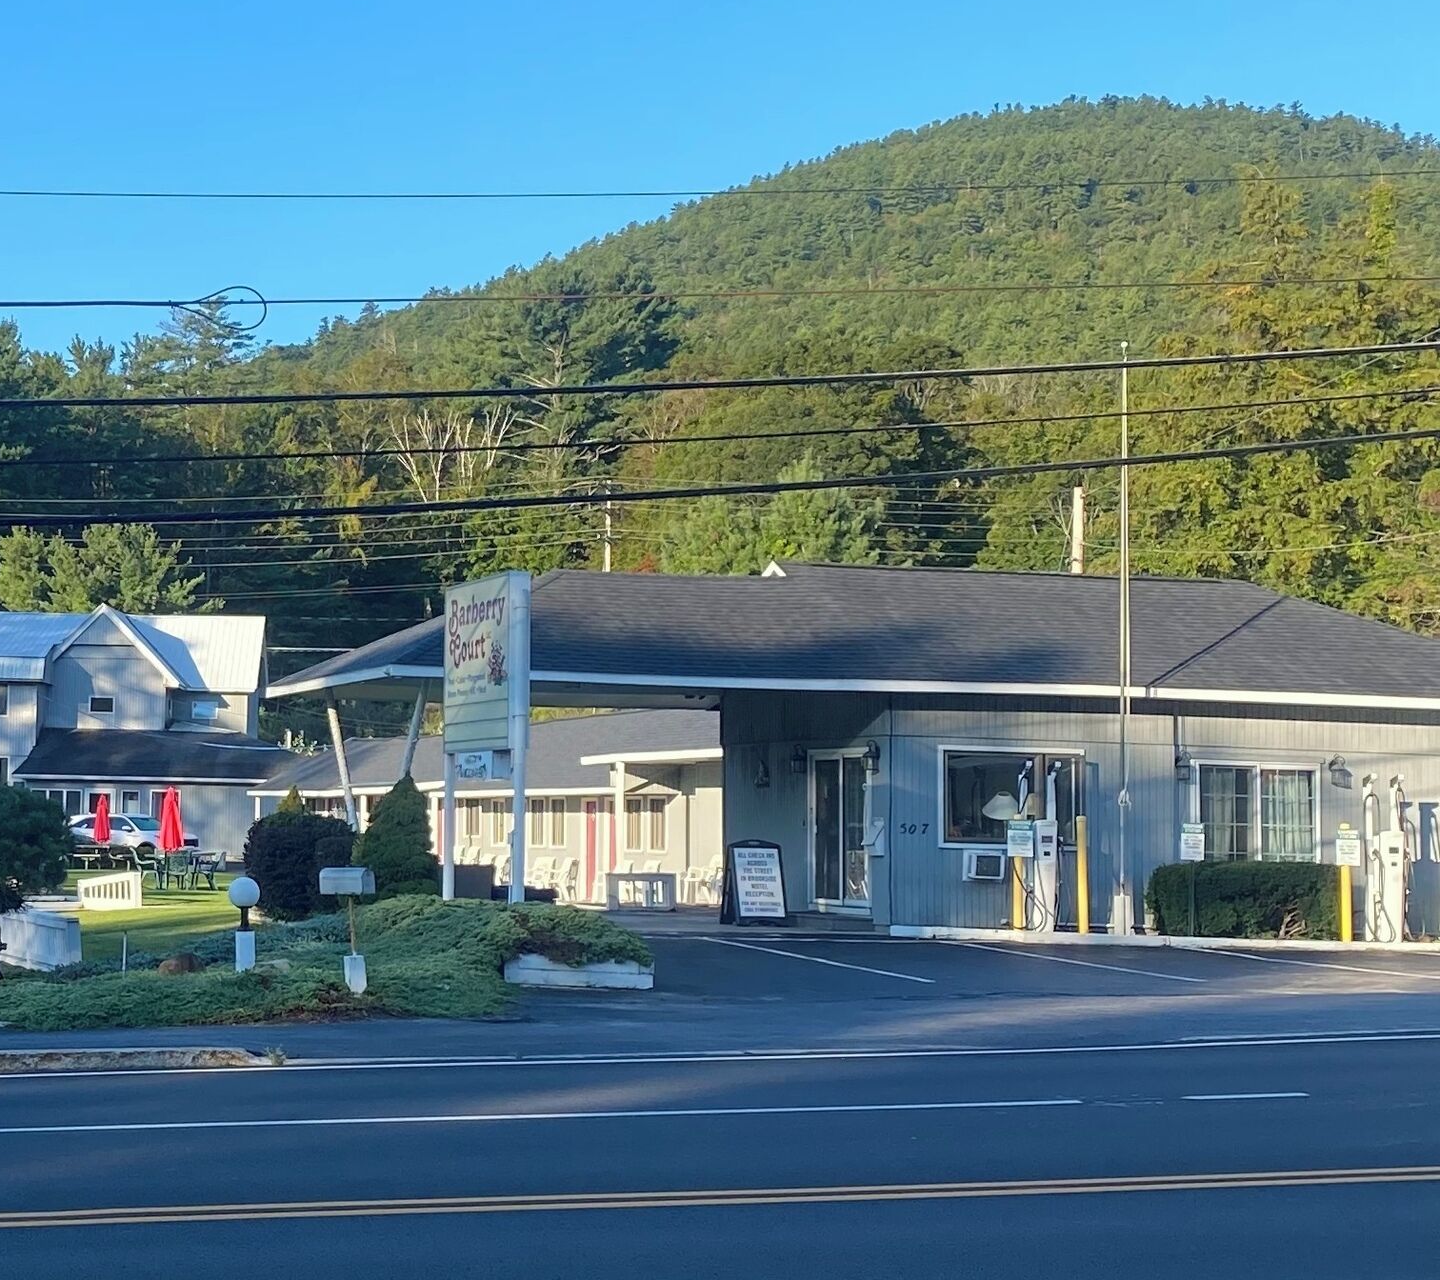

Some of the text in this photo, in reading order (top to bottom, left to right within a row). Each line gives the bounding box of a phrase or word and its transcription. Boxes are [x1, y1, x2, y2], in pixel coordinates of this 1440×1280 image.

[448, 593, 506, 638] Barberry
[449, 632, 486, 669] Court
[899, 822, 930, 835] 507
